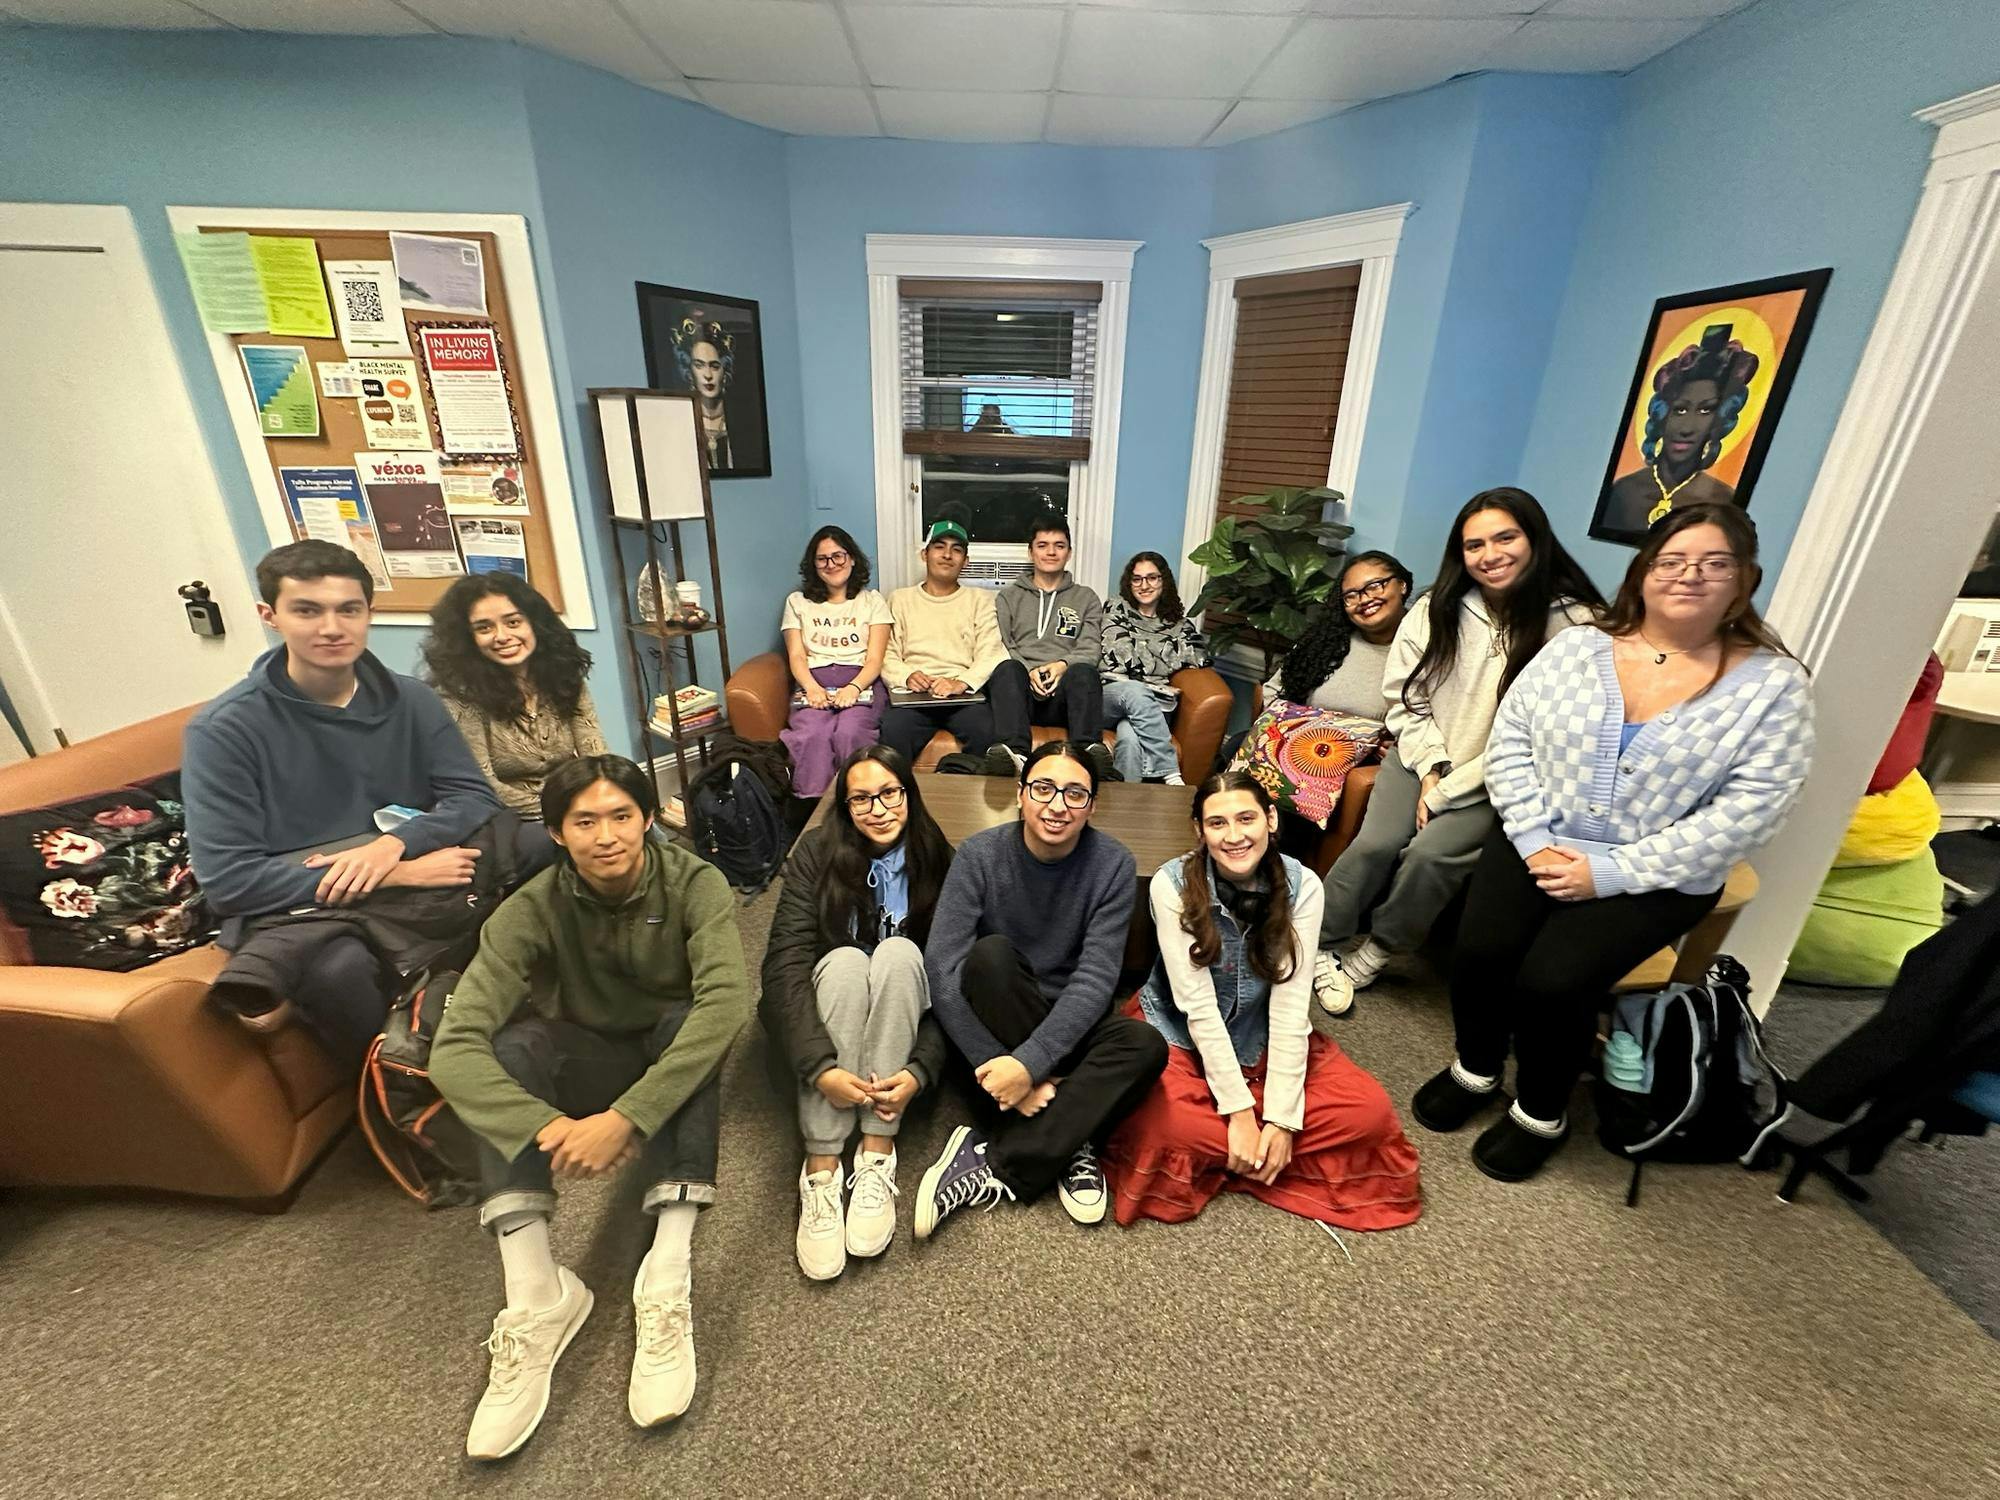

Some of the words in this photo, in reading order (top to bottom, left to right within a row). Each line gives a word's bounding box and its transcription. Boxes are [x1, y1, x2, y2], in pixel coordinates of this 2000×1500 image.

[429, 337, 444, 348] IN
[446, 337, 489, 349] LIVING
[433, 349, 489, 360] MEMORY
[365, 406, 393, 414] EXPERIENCE
[371, 460, 426, 476] véxoa
[812, 617, 857, 628] HASTA
[811, 632, 860, 648] LUEGO
